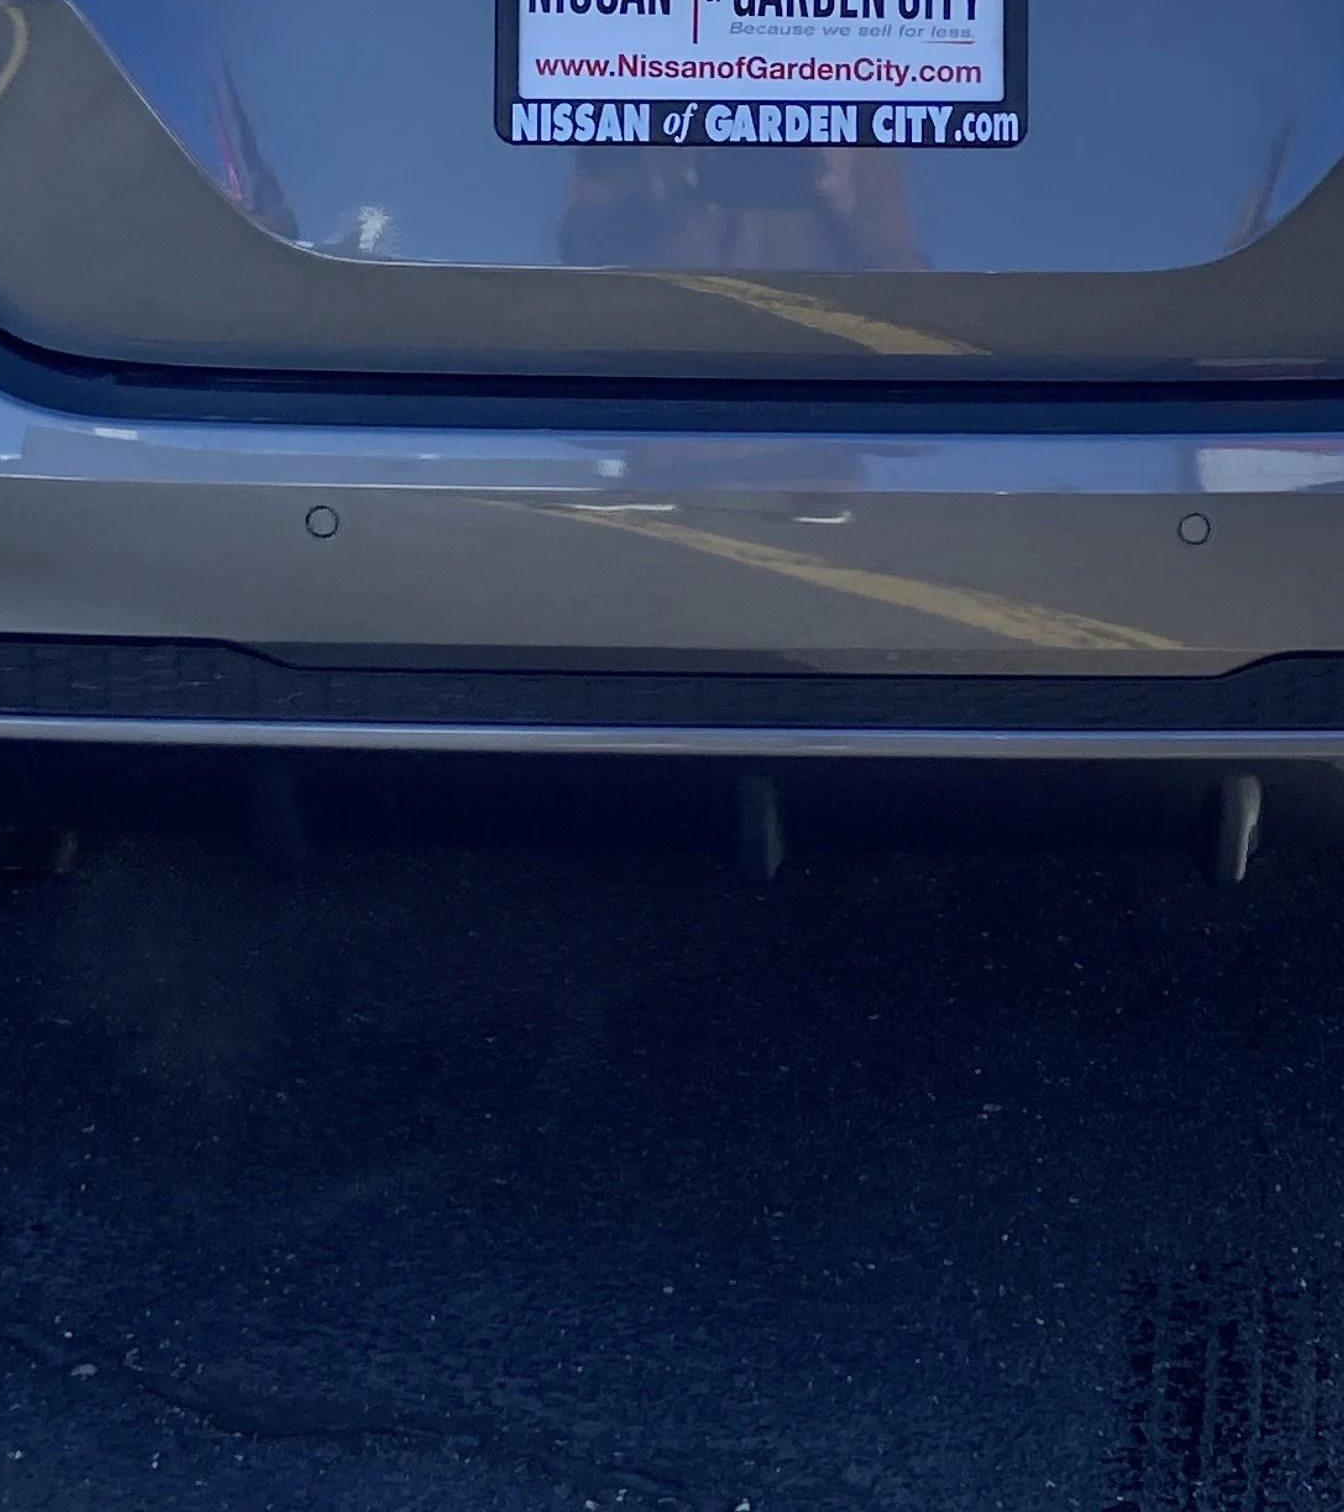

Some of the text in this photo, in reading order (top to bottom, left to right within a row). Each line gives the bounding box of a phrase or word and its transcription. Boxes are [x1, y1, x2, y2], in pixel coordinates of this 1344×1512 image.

[729, 21, 976, 40] Because we sell for less.
[535, 53, 983, 87] www.NissanofGardenCity.com
[511, 102, 1020, 144] NISSAN of GARDEN CITY.com
